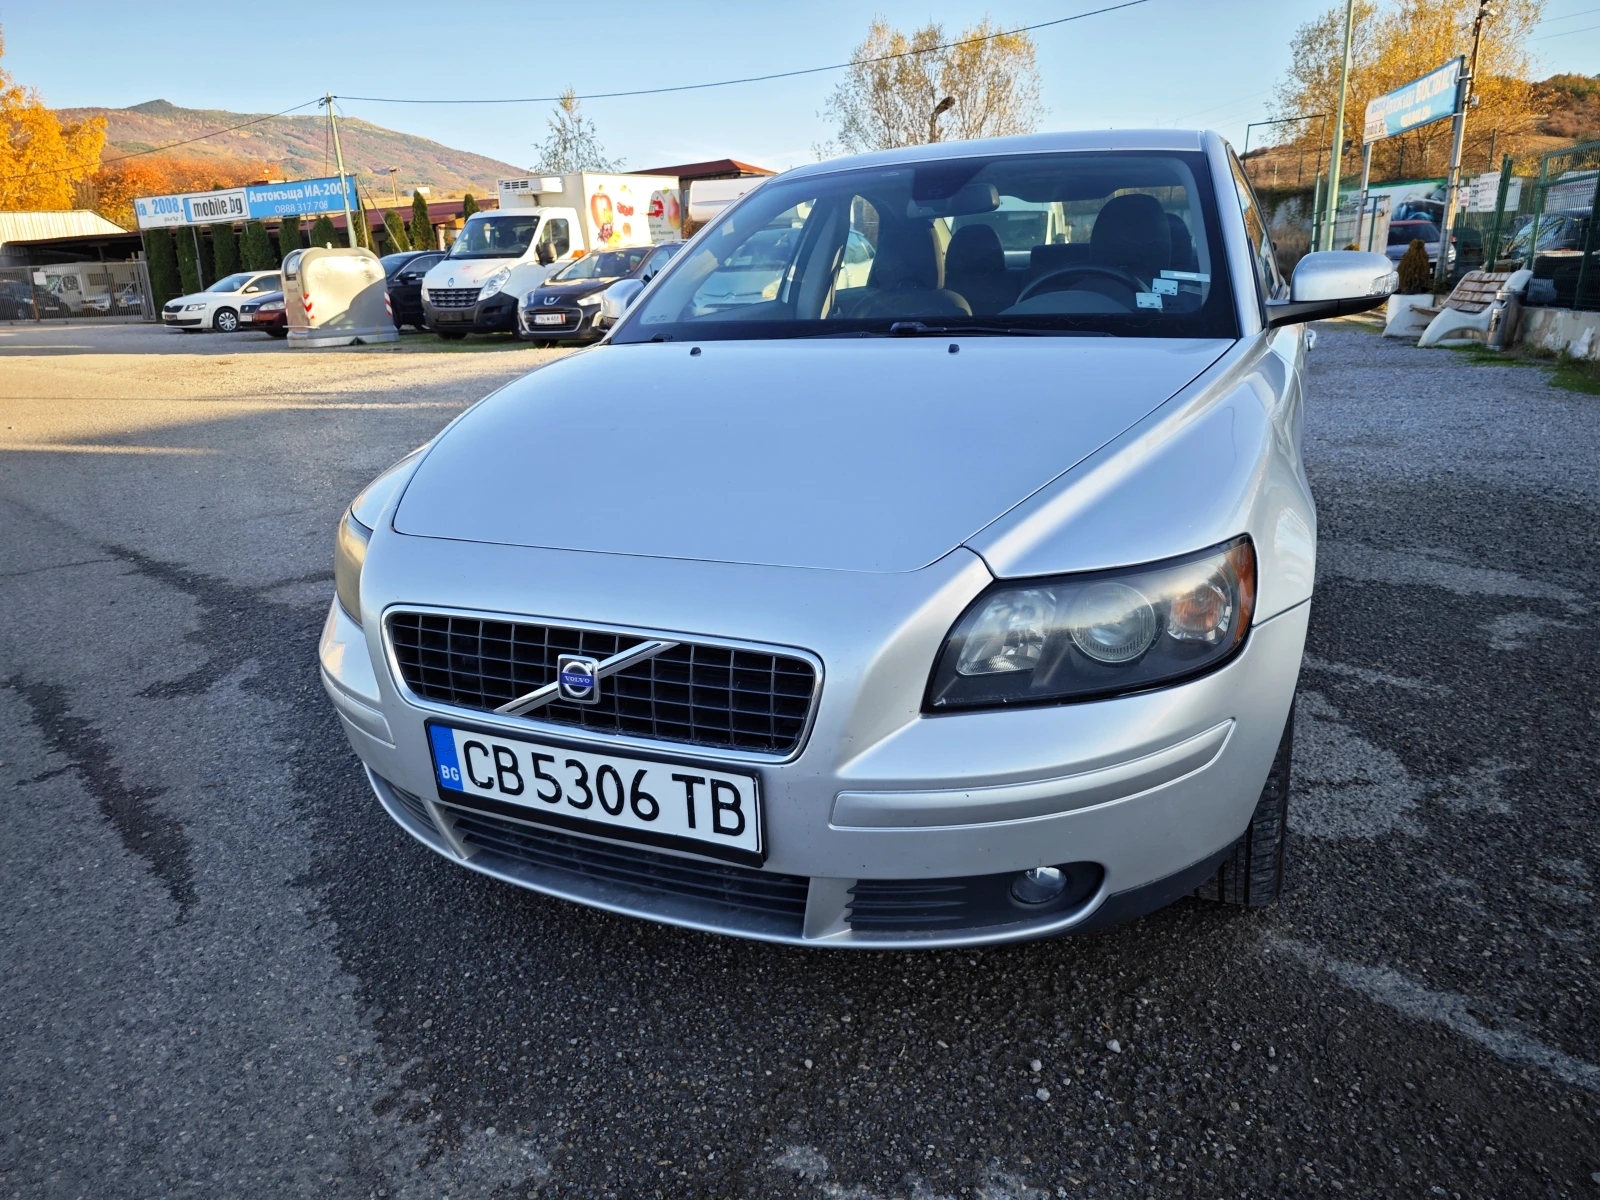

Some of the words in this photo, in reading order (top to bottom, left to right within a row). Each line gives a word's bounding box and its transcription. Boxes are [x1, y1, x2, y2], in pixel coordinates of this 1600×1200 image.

[249, 190, 303, 203] Автокъща
[193, 196, 243, 217] mobile.bg
[275, 203, 296, 214] 0888
[297, 202, 311, 212] 317
[314, 200, 328, 210] 708
[564, 675, 591, 684] VOLVO
[440, 764, 460, 781] BG
[672, 773, 746, 836] TB
